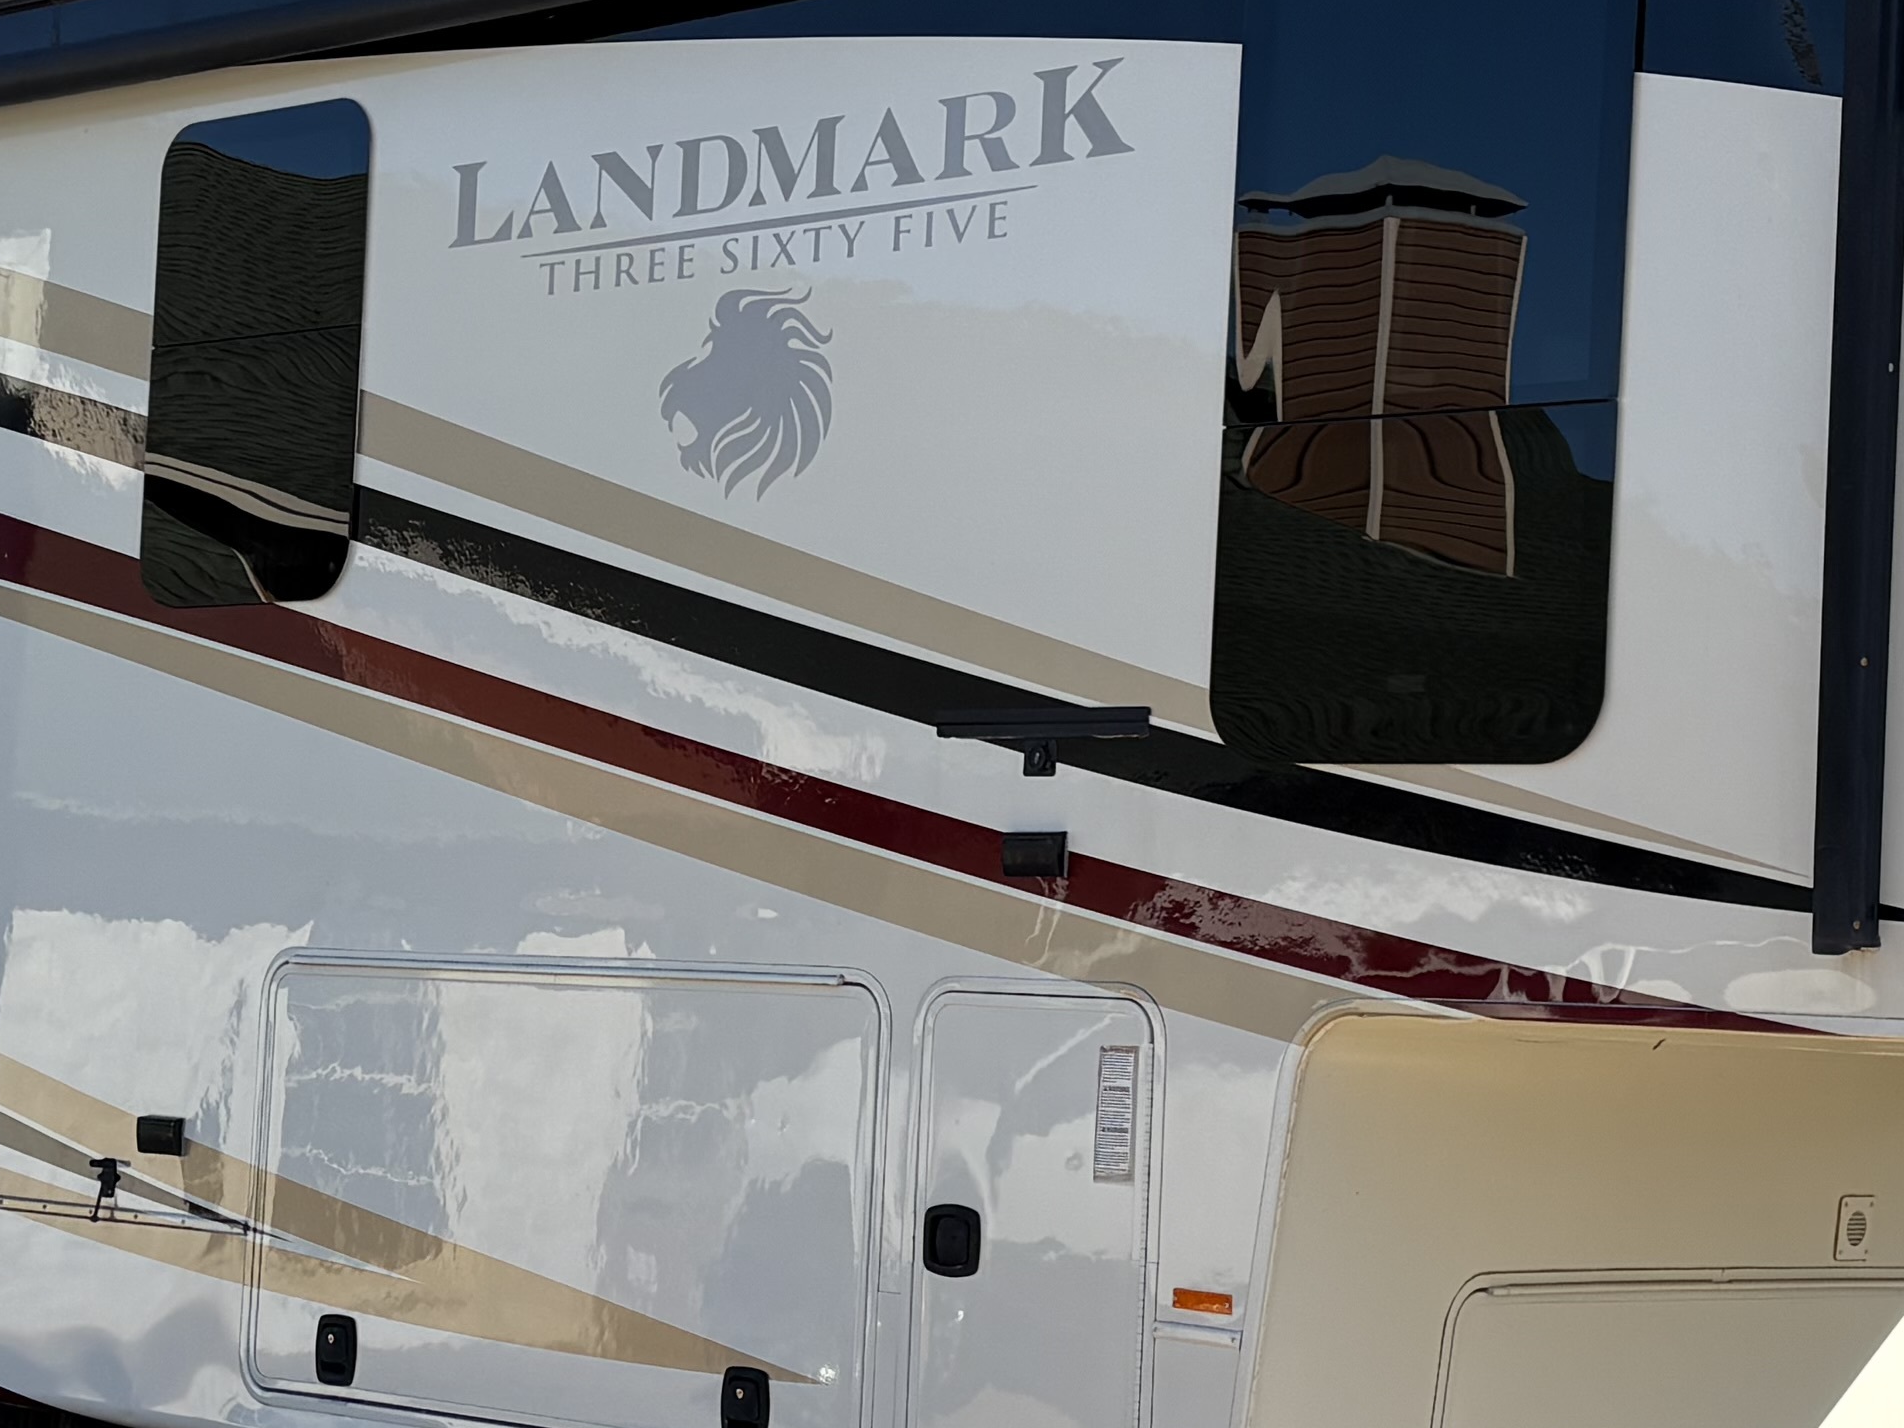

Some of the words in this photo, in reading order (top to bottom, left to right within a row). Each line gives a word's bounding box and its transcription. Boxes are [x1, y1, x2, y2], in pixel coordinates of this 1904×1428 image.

[448, 56, 1136, 249] LANDMARK
[540, 239, 696, 296] THREE
[719, 222, 866, 275] SIXTY
[892, 200, 1010, 253] FIVE
